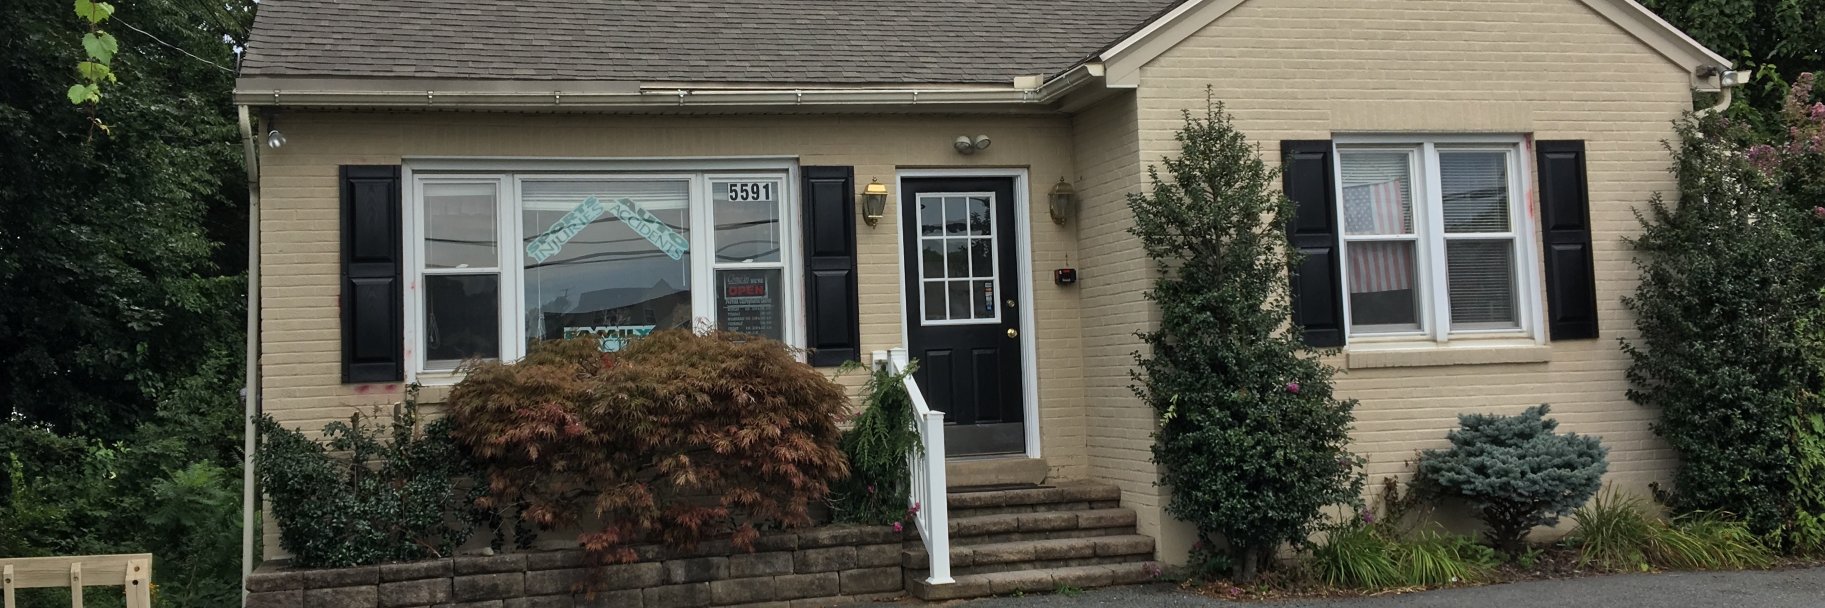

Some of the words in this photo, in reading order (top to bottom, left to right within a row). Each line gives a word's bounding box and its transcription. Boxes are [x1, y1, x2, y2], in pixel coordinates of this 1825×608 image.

[729, 183, 770, 201] 5591
[527, 196, 599, 253] SPORTS
[534, 204, 604, 261] INJURIES
[611, 204, 684, 260] ACCIDENTS
[617, 198, 689, 250] AUTO
[728, 285, 764, 296] OPEN
